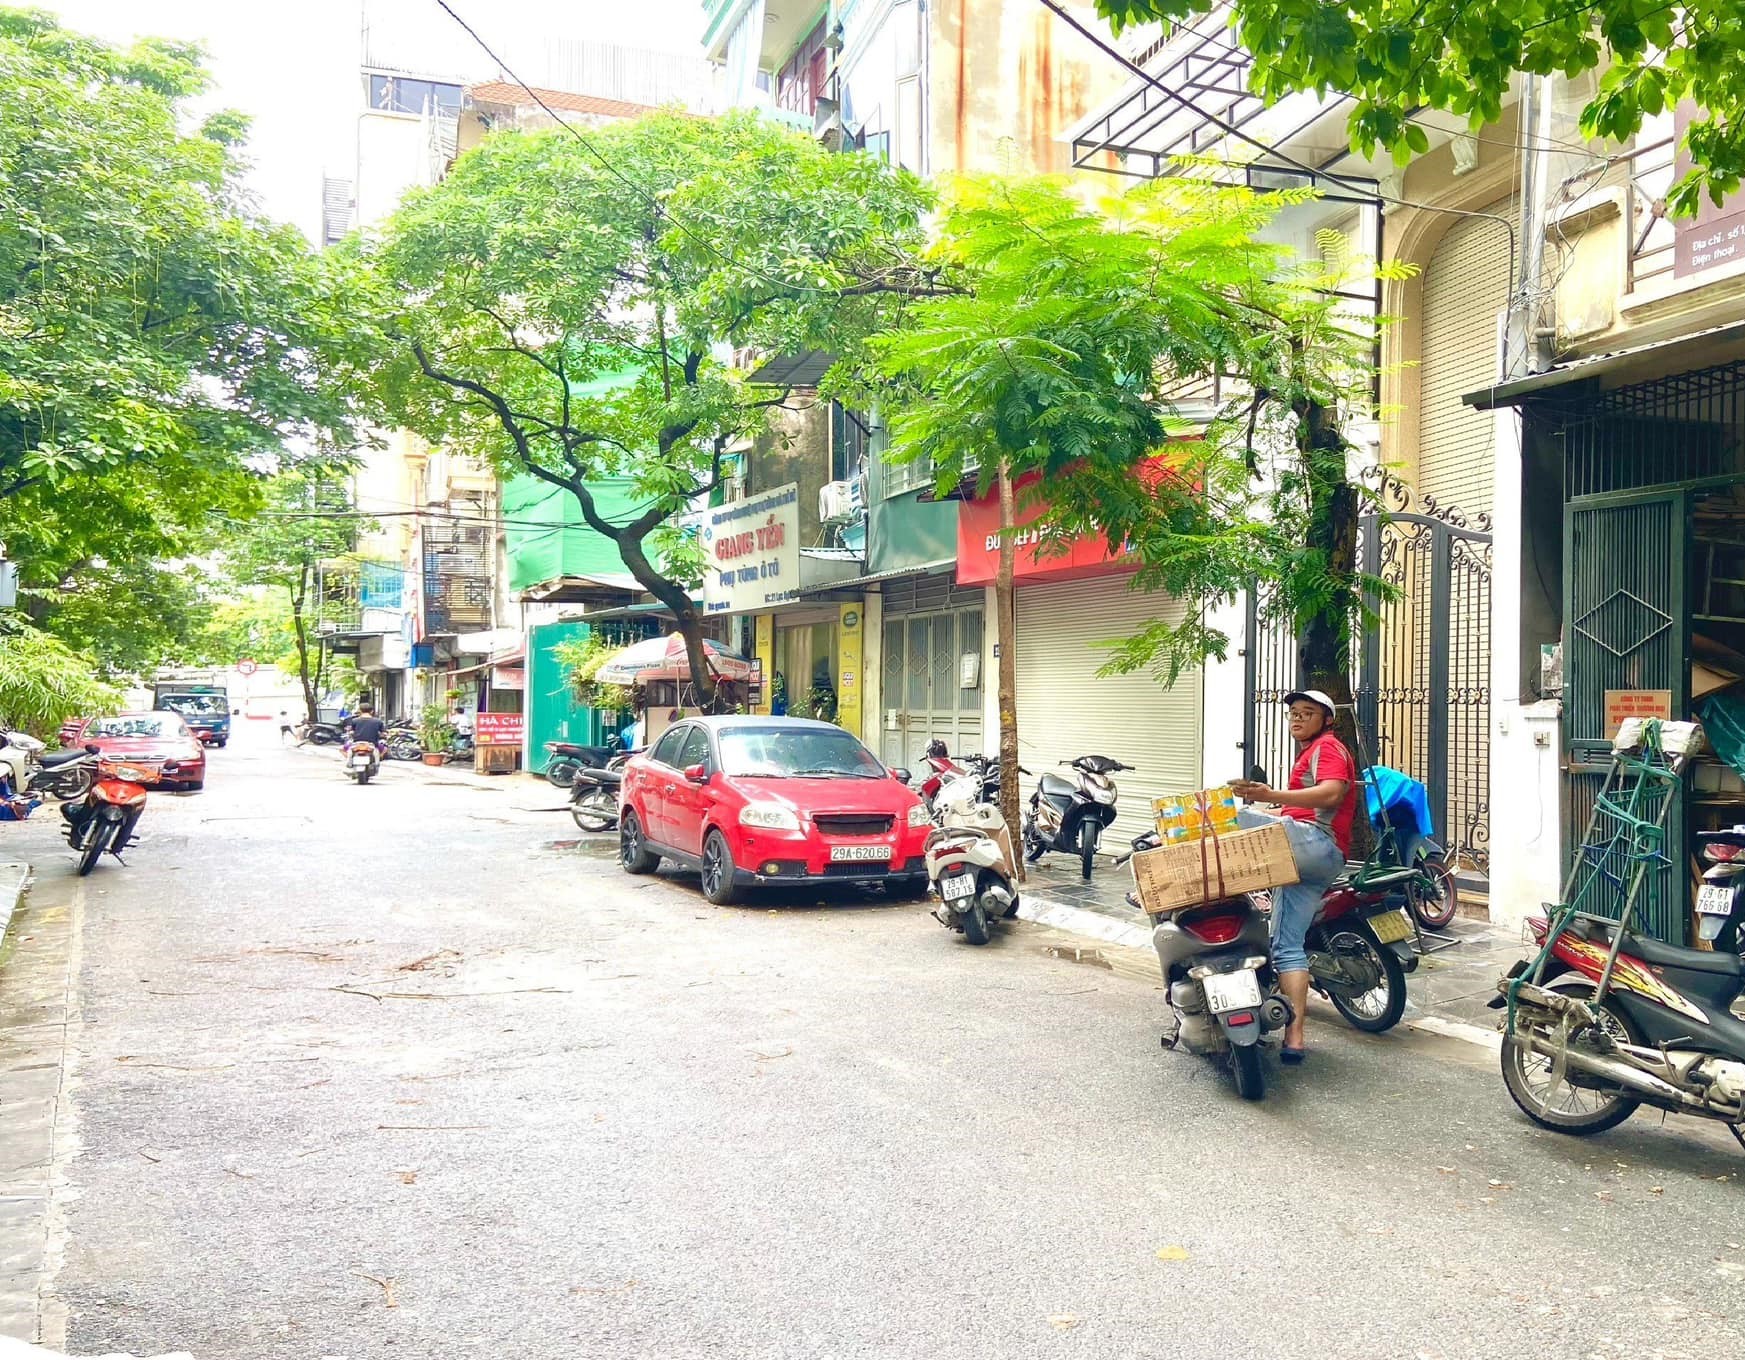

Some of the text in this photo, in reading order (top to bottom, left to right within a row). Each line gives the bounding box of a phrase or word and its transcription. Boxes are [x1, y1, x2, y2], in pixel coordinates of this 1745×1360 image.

[1727, 225, 1740, 240] số
[715, 531, 754, 561] GIANG
[755, 514, 785, 550] YẾN
[760, 560, 768, 579] Ô
